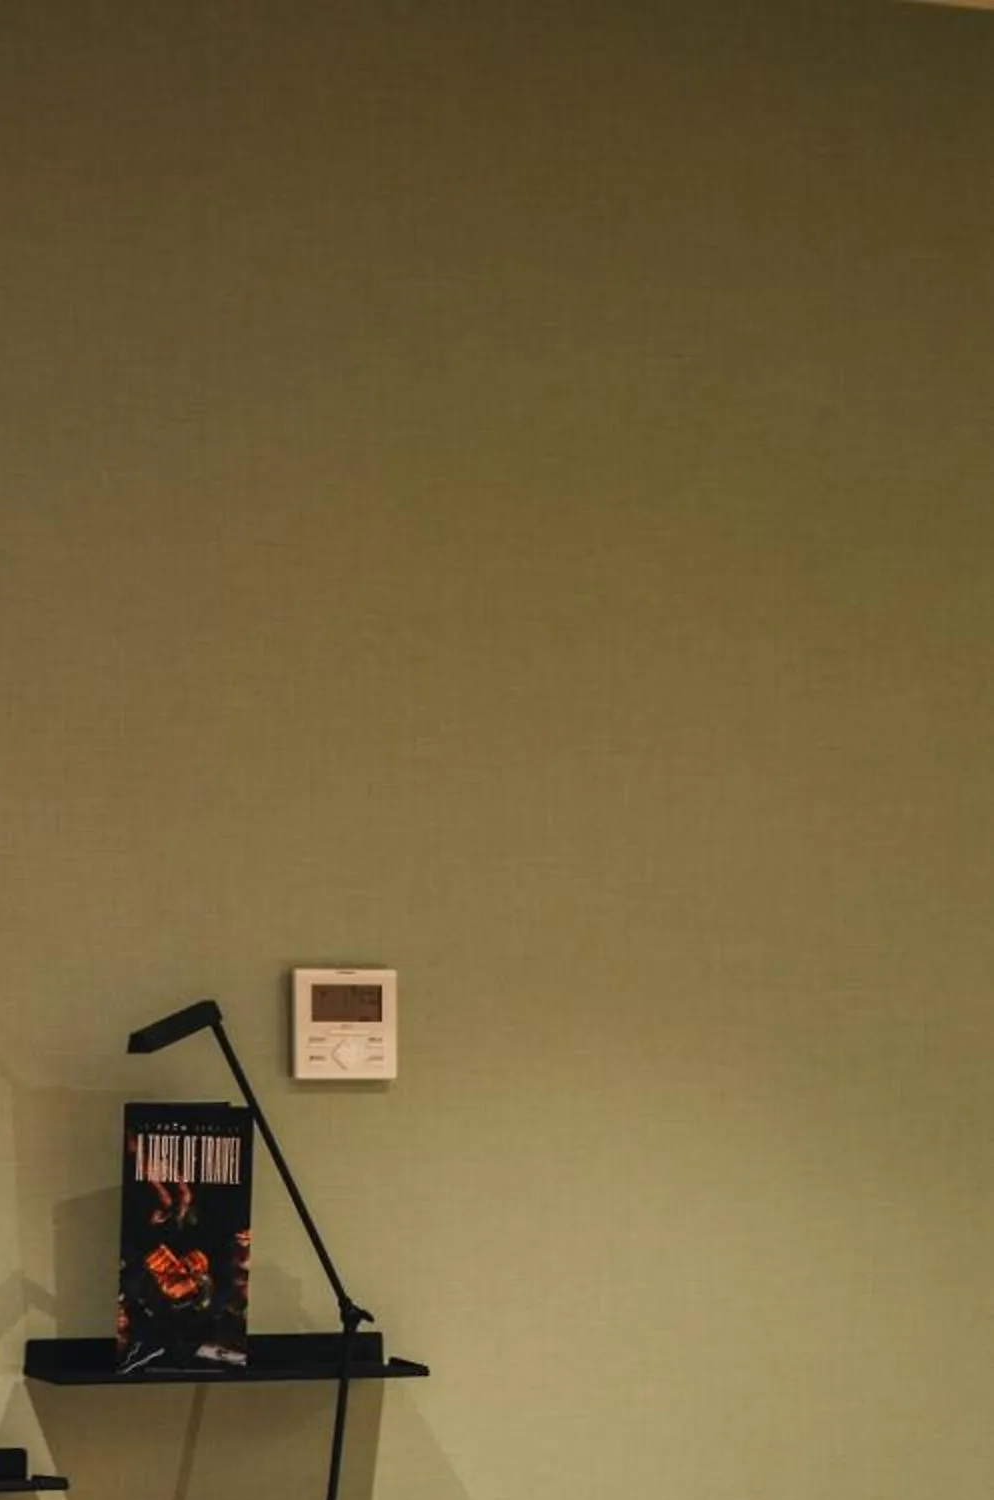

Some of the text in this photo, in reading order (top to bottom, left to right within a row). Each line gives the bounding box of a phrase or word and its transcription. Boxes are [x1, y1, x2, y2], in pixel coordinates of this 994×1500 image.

[135, 1134, 241, 1185] A TASTE OF TRAVEL
